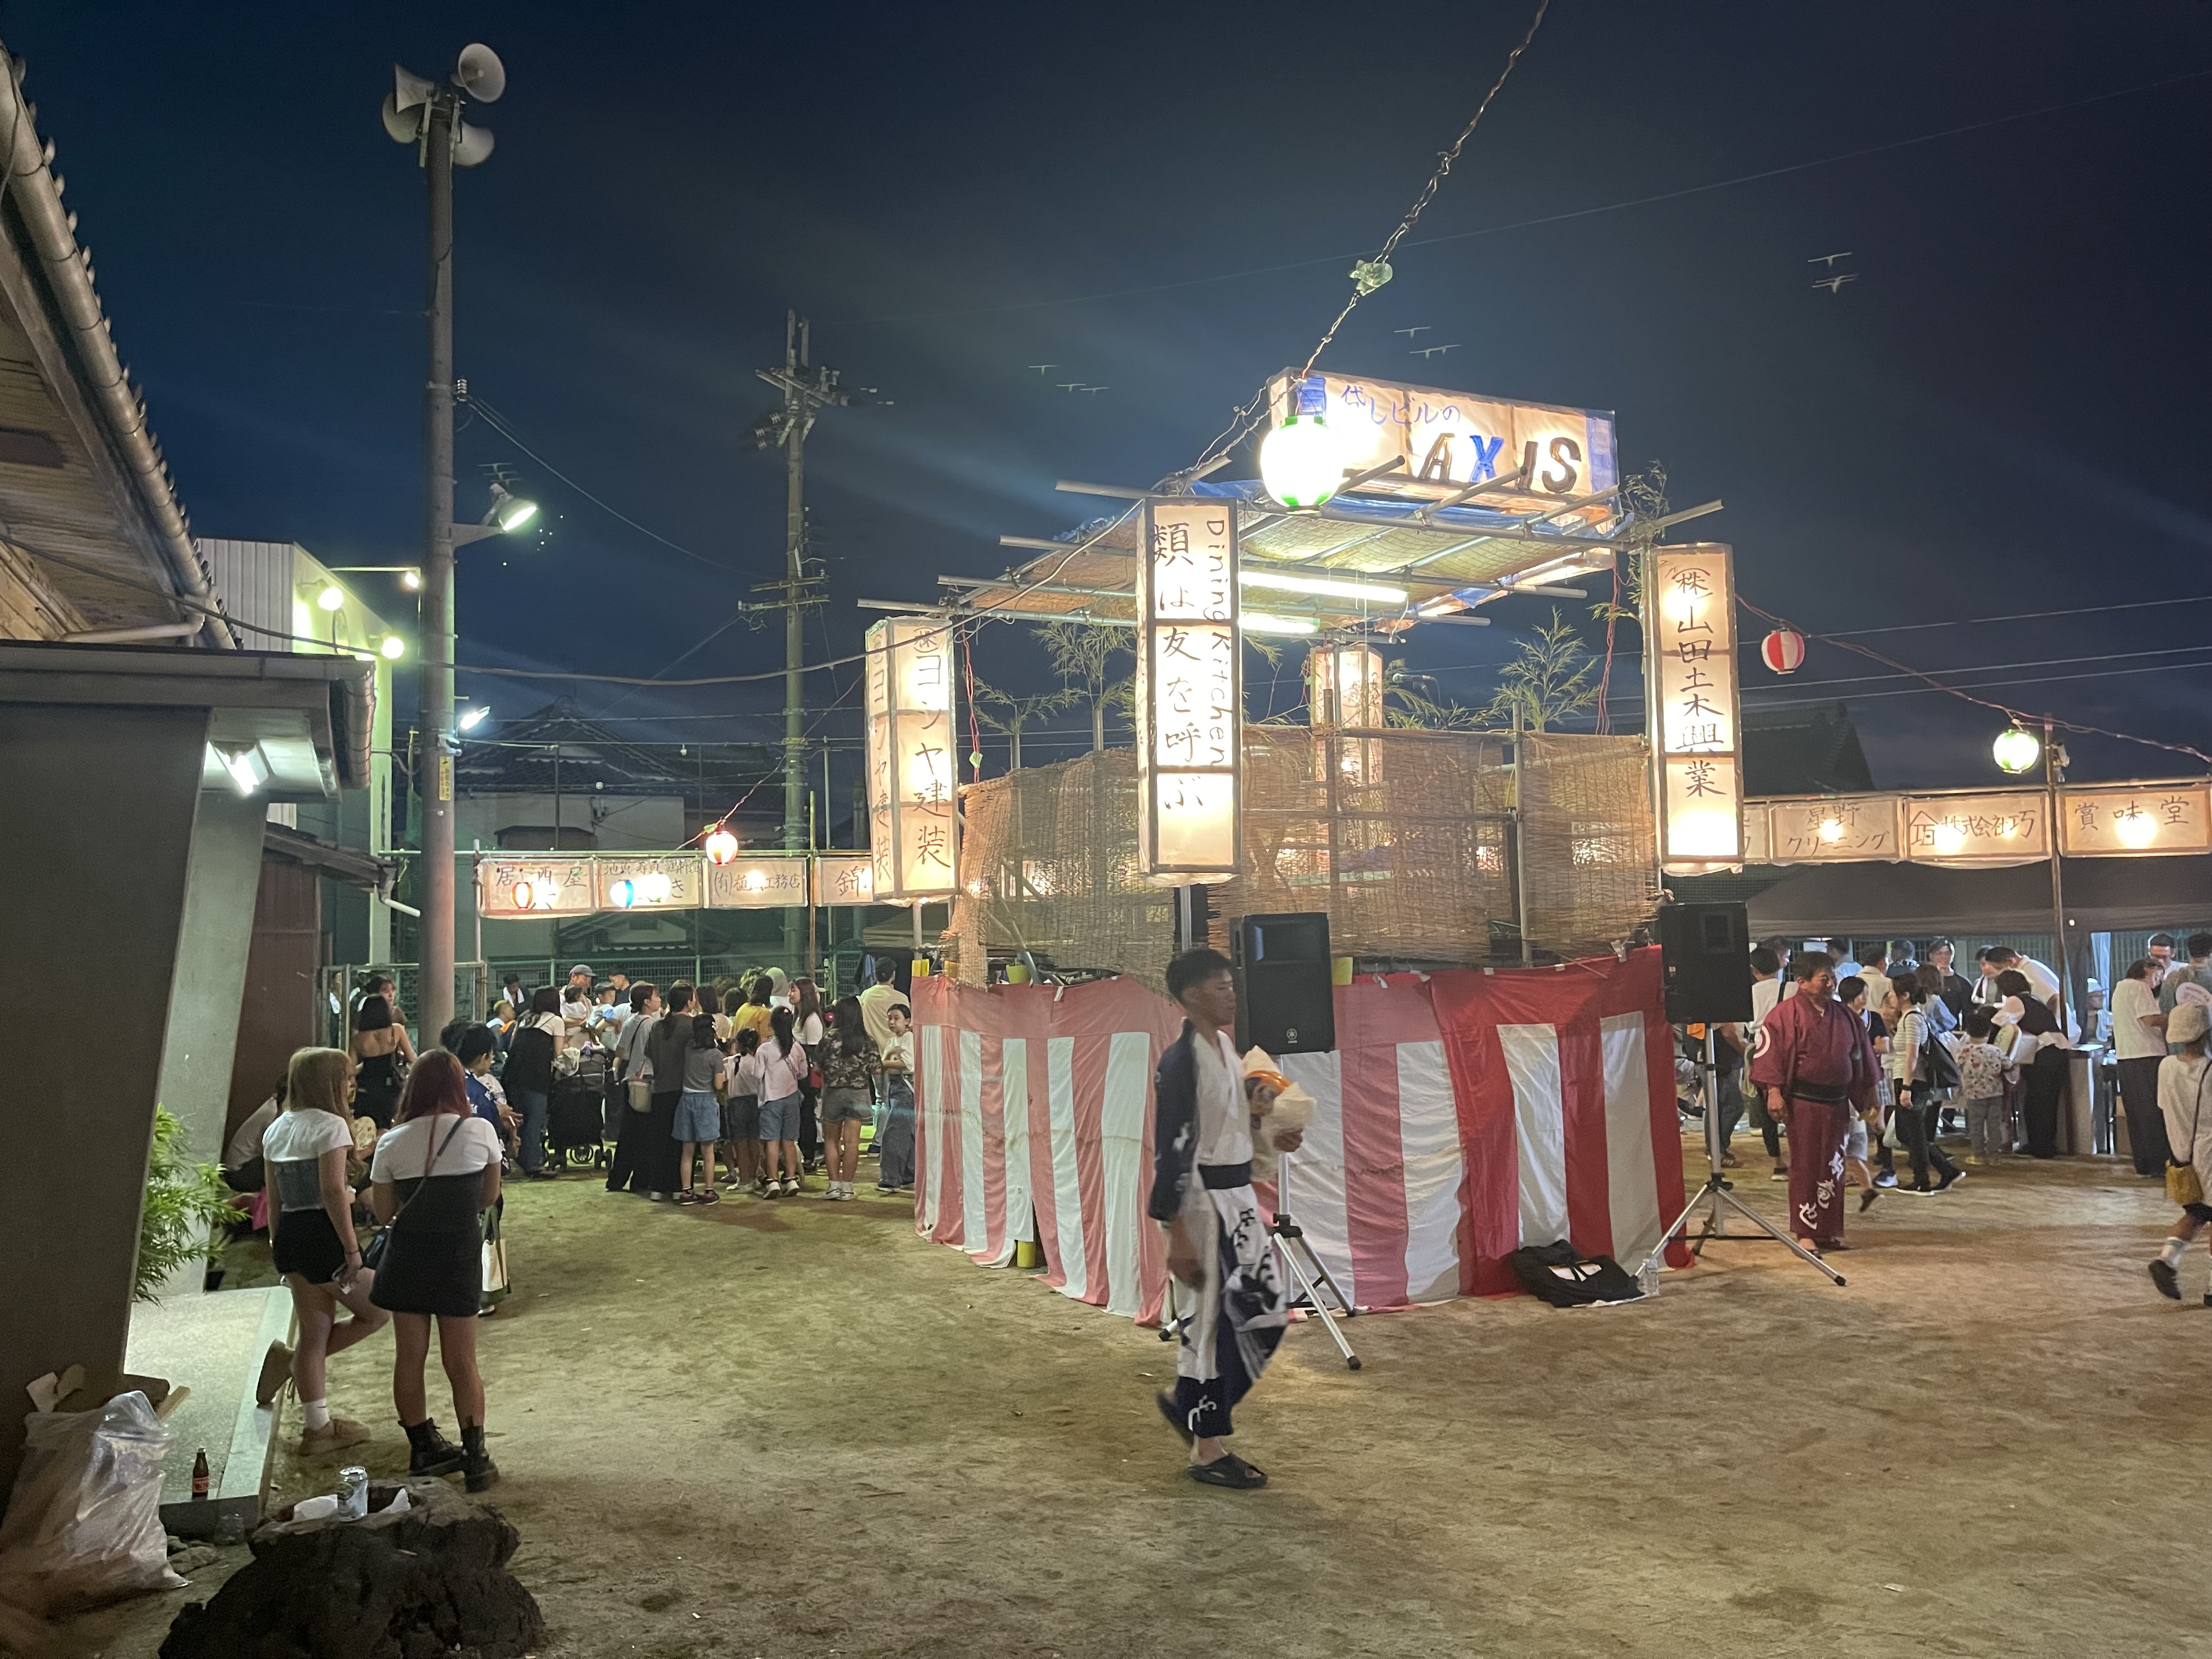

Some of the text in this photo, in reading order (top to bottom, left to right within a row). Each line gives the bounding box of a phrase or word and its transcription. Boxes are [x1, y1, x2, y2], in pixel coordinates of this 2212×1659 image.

[1417, 432, 1582, 494] AXIS
[1203, 520, 1233, 766] Dining Kitchen
[1807, 803, 1860, 832] 星野
[2074, 795, 2190, 831] 賞味堂
[1786, 830, 1890, 856] クリーニング
[714, 871, 801, 897] (有)植工務店
